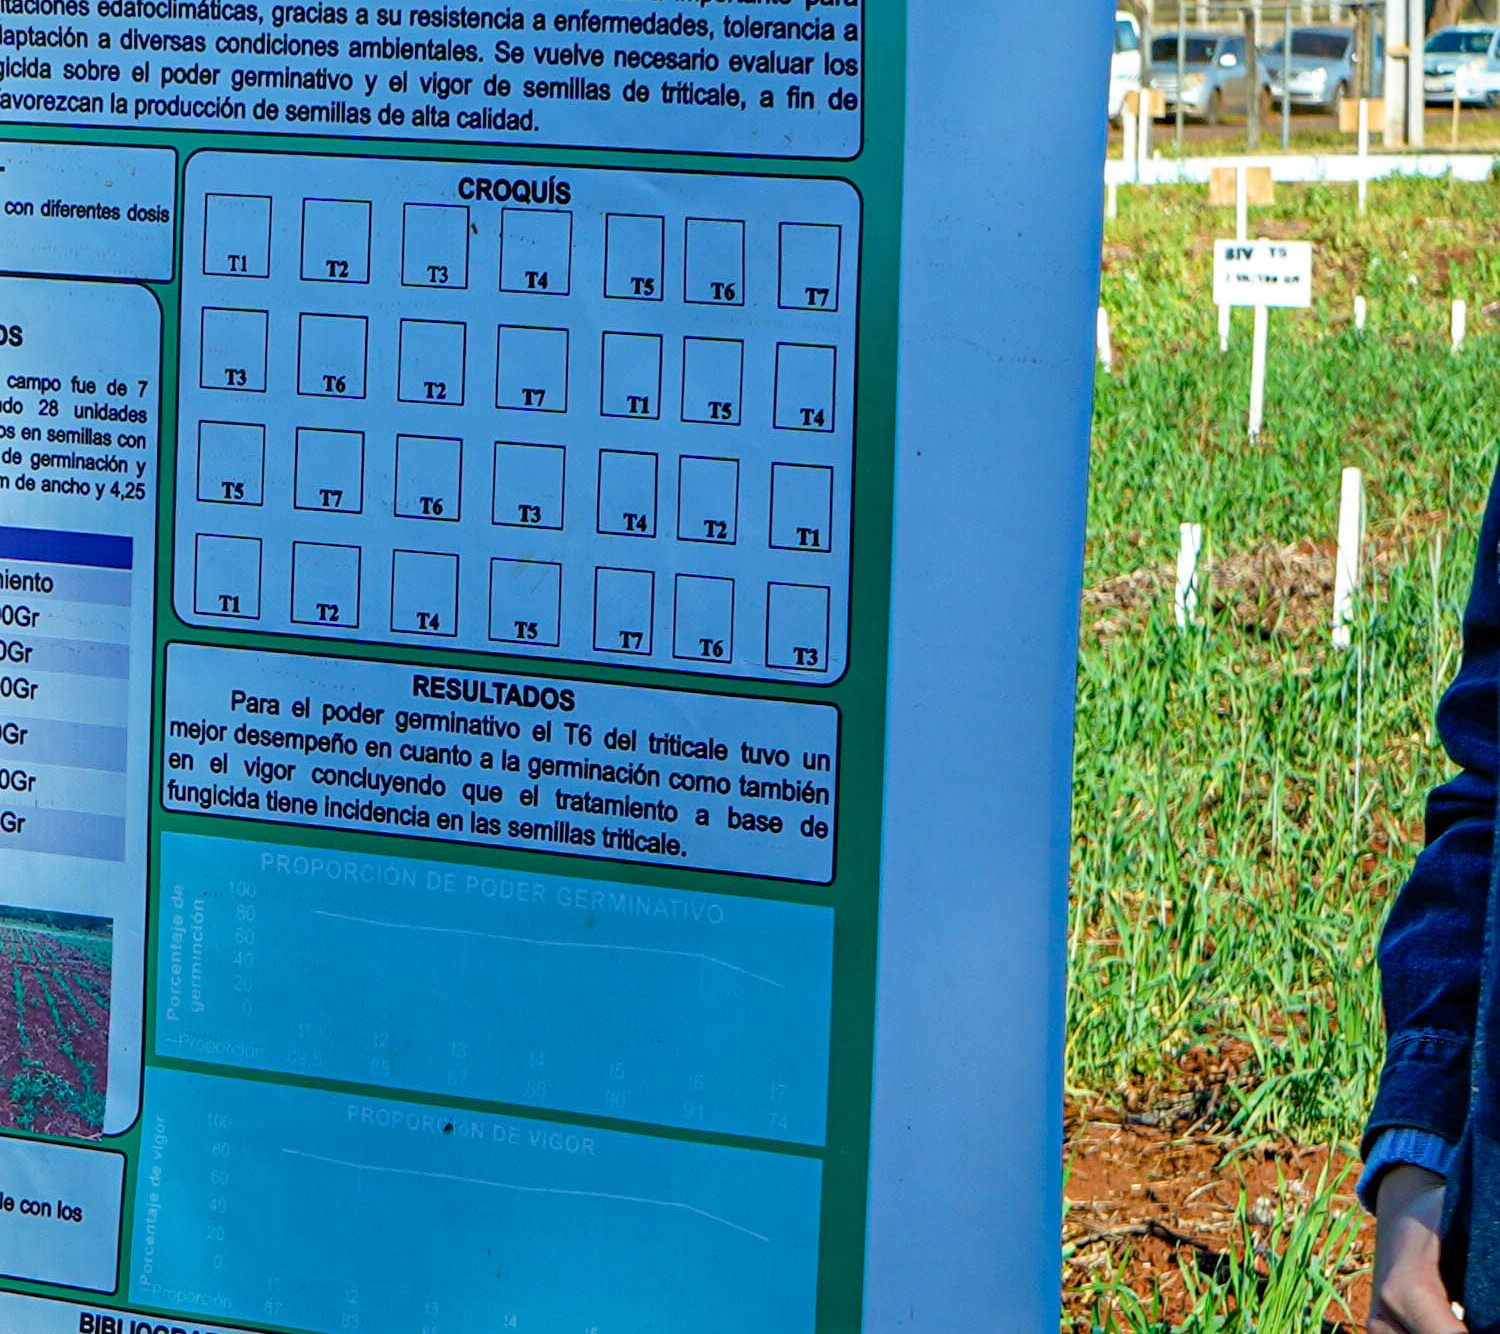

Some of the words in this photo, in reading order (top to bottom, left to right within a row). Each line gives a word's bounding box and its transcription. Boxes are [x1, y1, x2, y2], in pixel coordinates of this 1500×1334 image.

[228, 255, 247, 272] T1
[326, 260, 348, 277] T2
[427, 266, 448, 283] T3
[525, 271, 547, 289] T4
[631, 277, 654, 296] T5
[711, 282, 735, 301] T6
[805, 287, 829, 306] T7
[413, 675, 575, 711] RESULTADOS
[428, 870, 455, 893] DE
[466, 874, 546, 904] PODER
[558, 885, 725, 924] GERMINATIVO
[493, 1123, 520, 1145] DE
[529, 1129, 595, 1155] VIGOR
